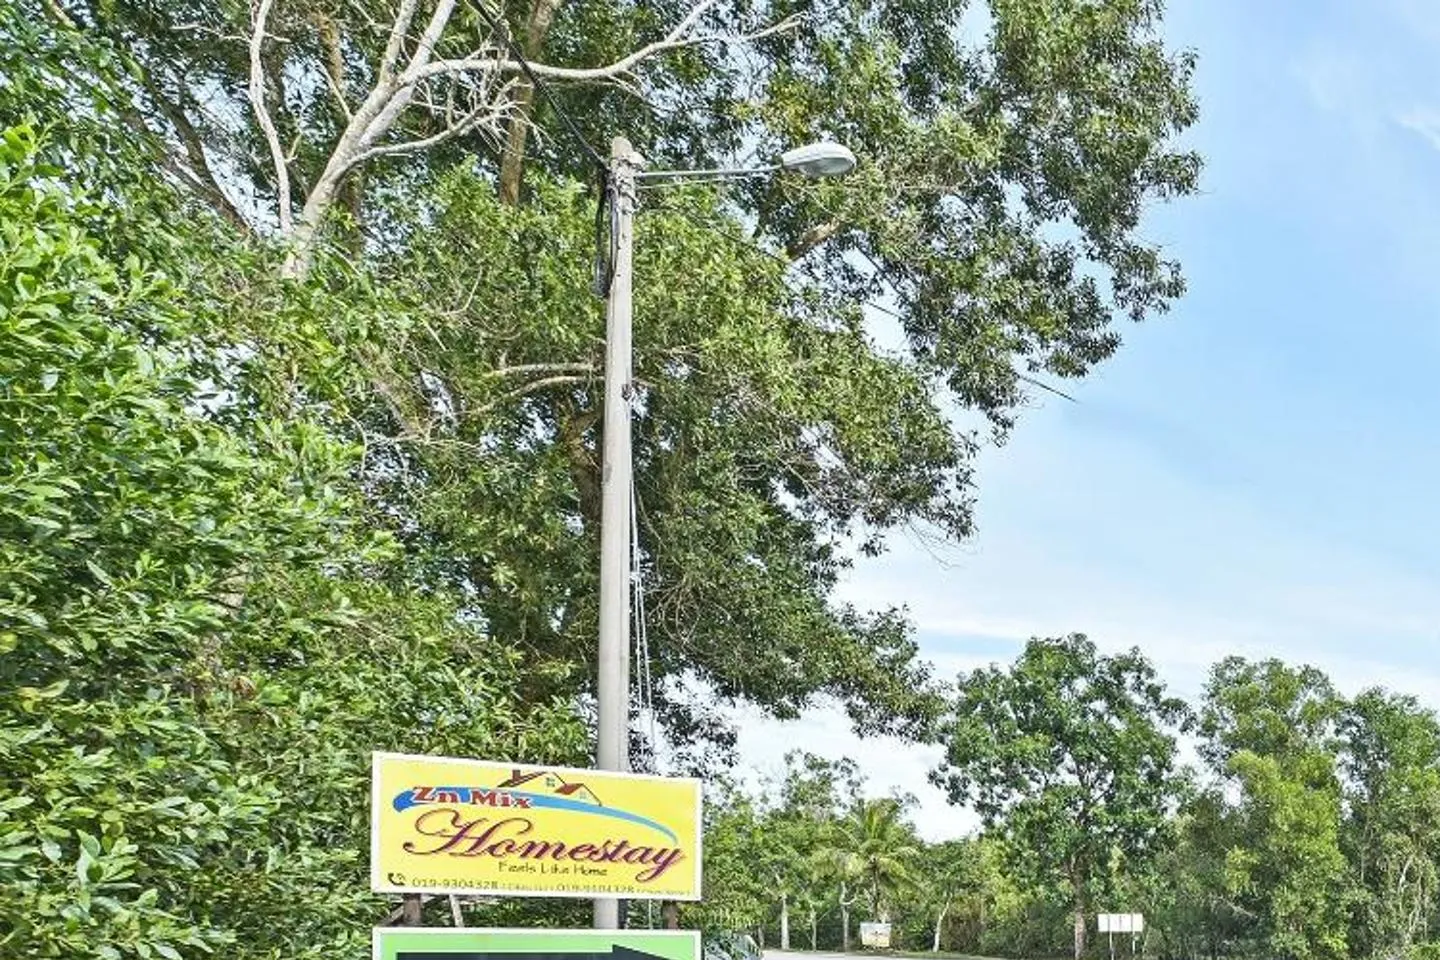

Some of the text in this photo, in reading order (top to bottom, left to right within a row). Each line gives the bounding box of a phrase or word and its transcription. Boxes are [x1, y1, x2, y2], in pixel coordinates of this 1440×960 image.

[411, 786, 532, 809] Zn Mix
[402, 808, 686, 884] Homestay
[574, 863, 608, 877] Home
